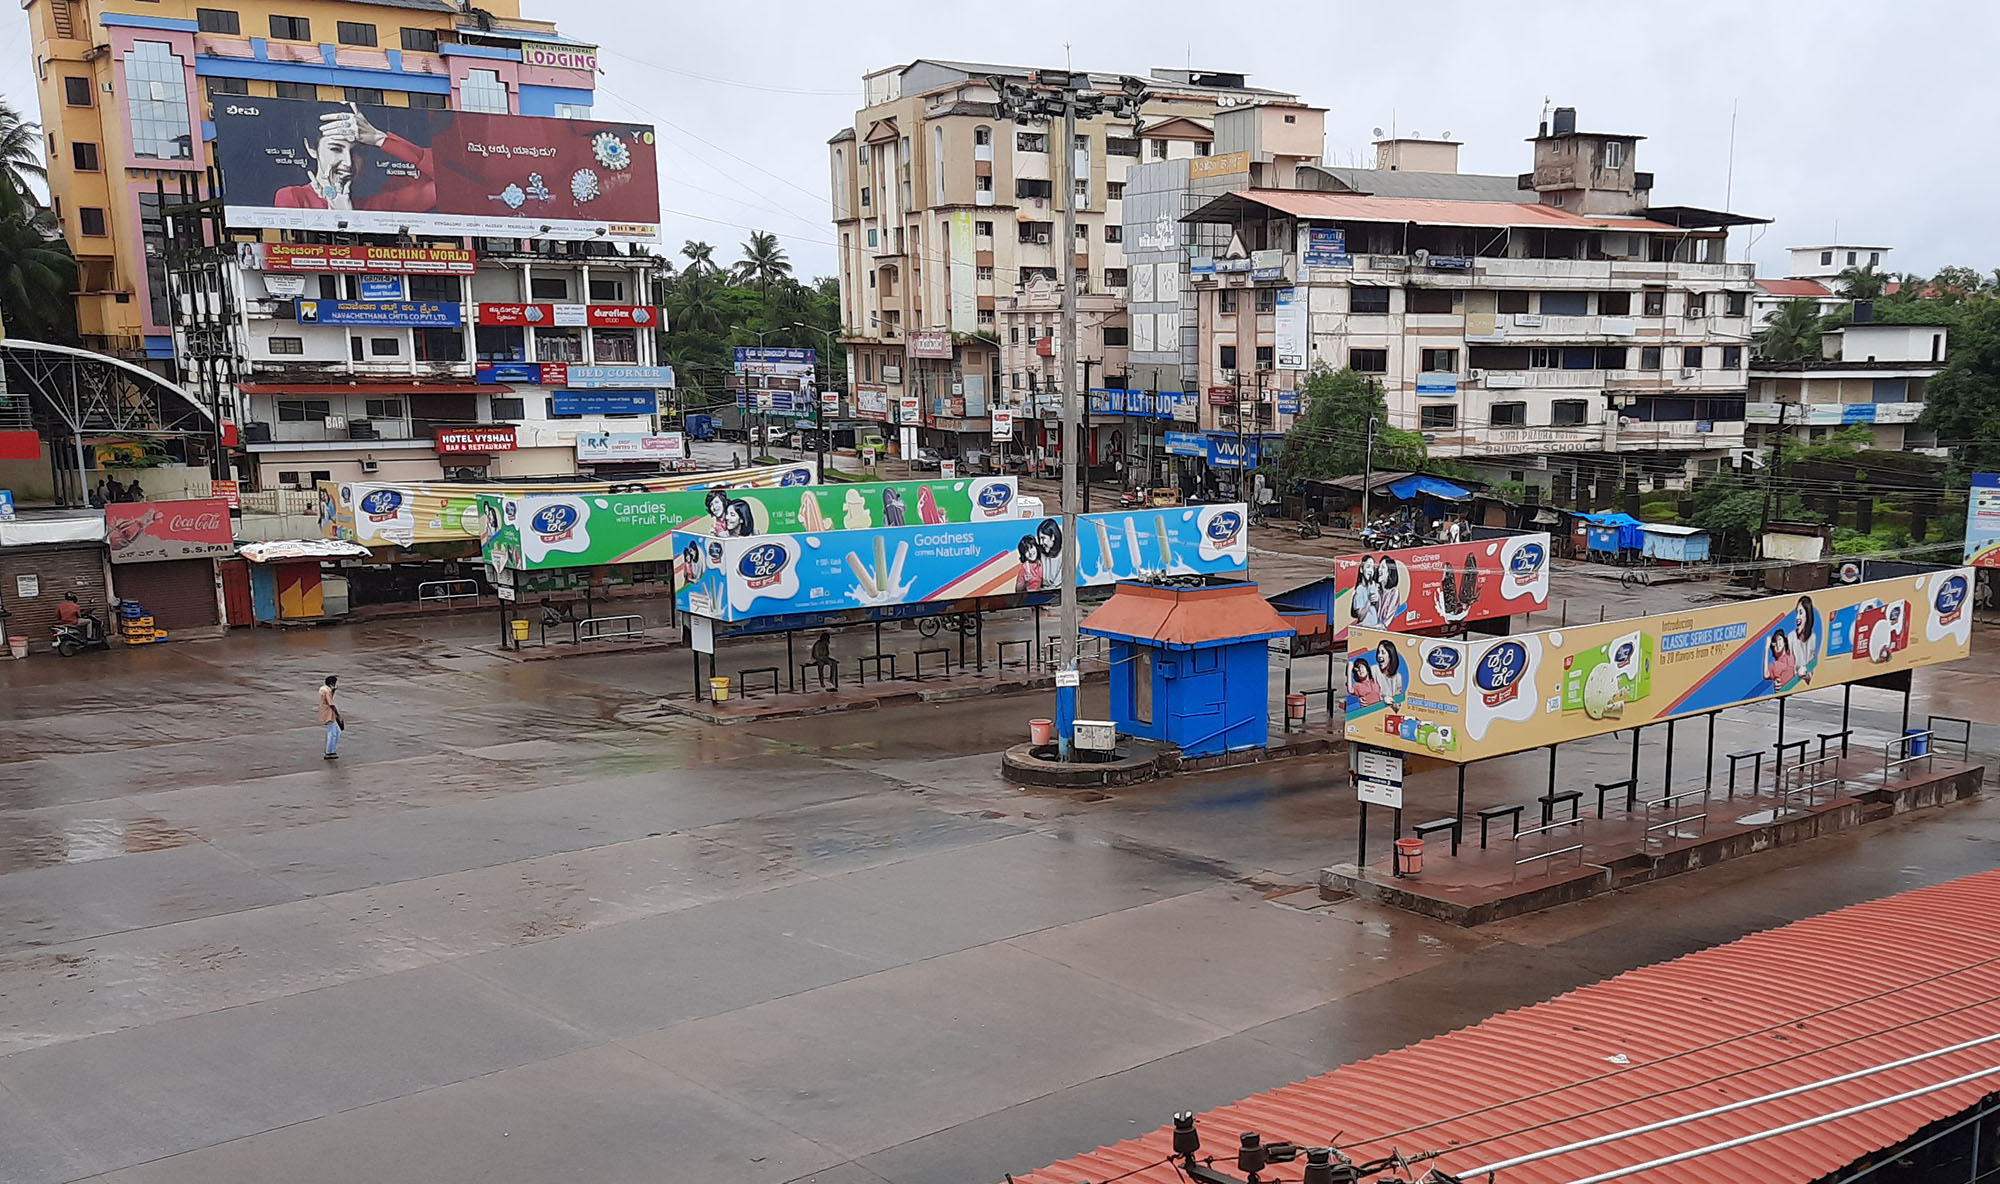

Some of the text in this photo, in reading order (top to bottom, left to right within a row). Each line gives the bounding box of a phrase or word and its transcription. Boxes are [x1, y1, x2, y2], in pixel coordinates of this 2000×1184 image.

[526, 50, 596, 69] LODGING
[367, 248, 469, 261] COACHING WORLD
[594, 308, 630, 318] duroflex
[577, 368, 603, 378] BED
[606, 368, 661, 378] CORNER
[324, 416, 345, 430] BAR
[442, 434, 514, 443] HOTEL VYSHALI
[468, 443, 511, 451] RESTAURANT
[1486, 443, 1588, 454] DRIVING SCHOOL
[983, 486, 1006, 499] Dairy
[613, 501, 666, 515] Candies
[986, 496, 1004, 507] Day
[632, 514, 657, 526] Fruit
[660, 513, 683, 526] Pulp
[1212, 515, 1236, 528] Dairy
[1215, 524, 1233, 538] Day
[914, 531, 975, 547] Goodness
[182, 545, 228, 554] S.S.PAI
[935, 543, 981, 558] Naturally
[1516, 547, 1538, 563] Dairy
[1519, 560, 1536, 573] Day
[1661, 618, 1694, 632] Introducing
[1662, 623, 1747, 650] CLASSIC SERIES ICE CREAM
[1432, 648, 1455, 662] Dairy
[1434, 657, 1451, 670] Day
